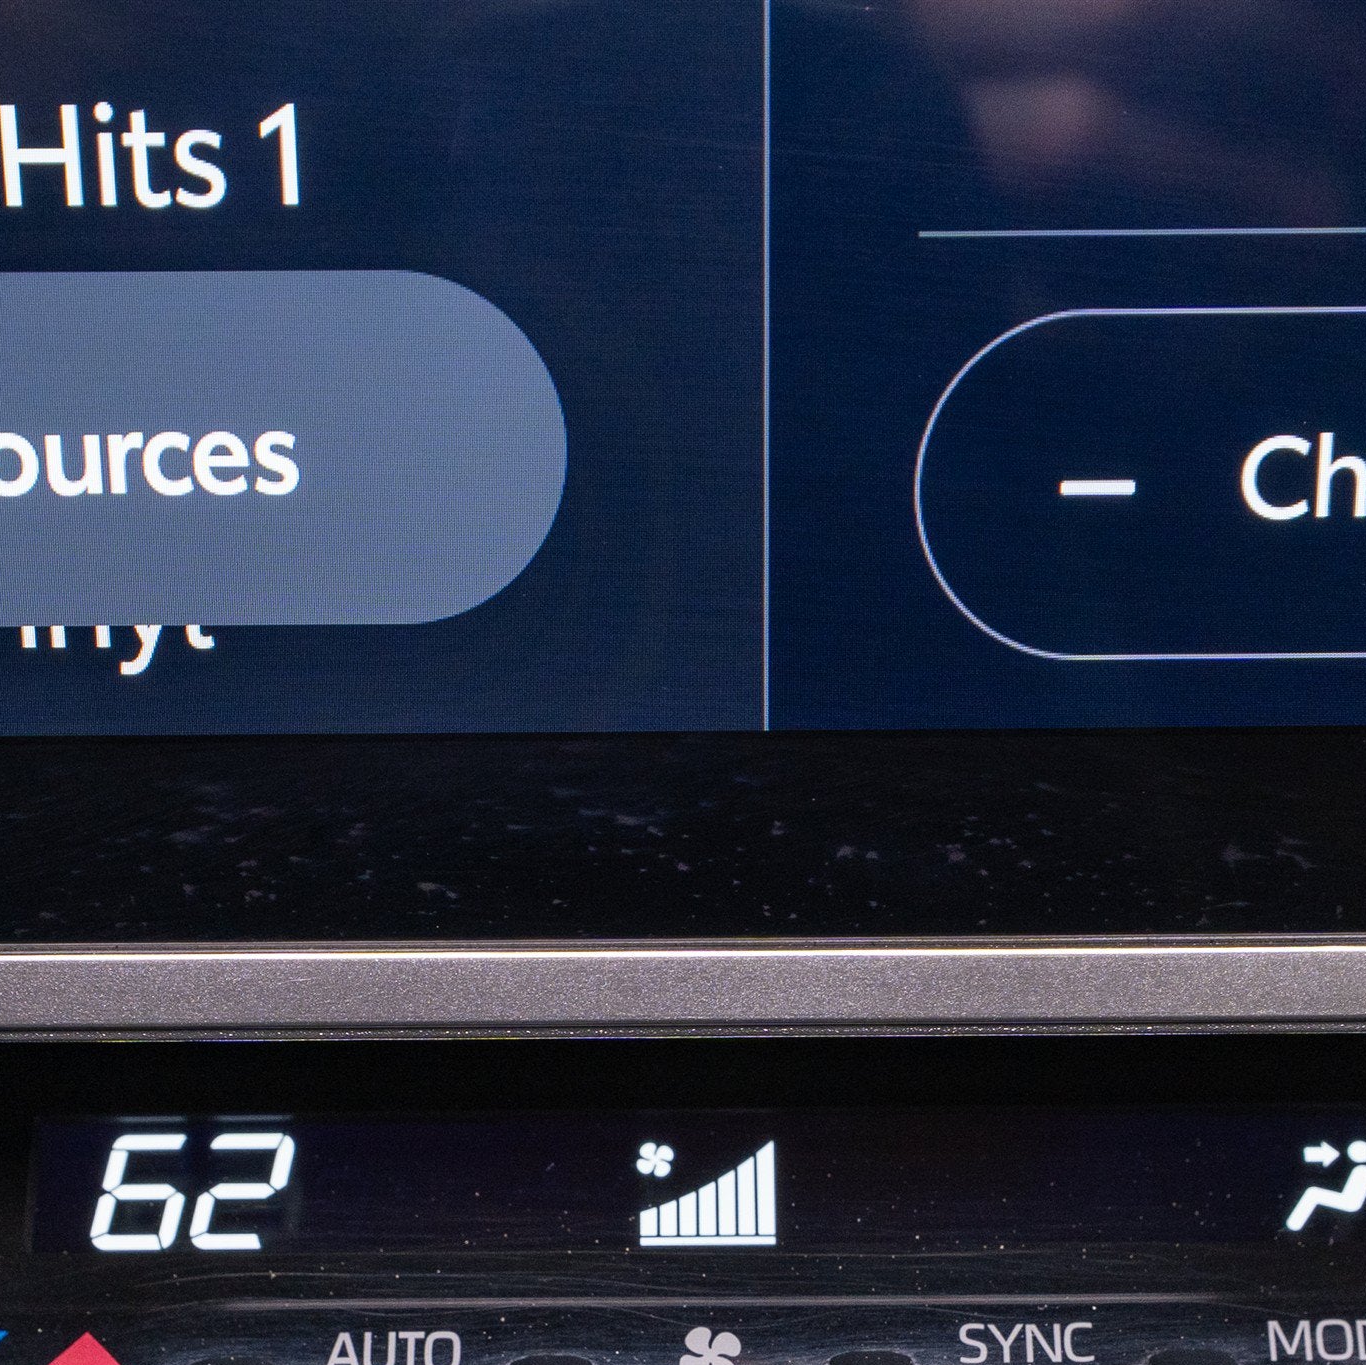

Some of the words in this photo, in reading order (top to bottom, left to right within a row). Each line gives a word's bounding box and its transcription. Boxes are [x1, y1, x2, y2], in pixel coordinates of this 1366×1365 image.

[257, 103, 302, 207] 1
[89, 1132, 296, 1253] 62
[959, 1322, 1096, 1365] SYNC
